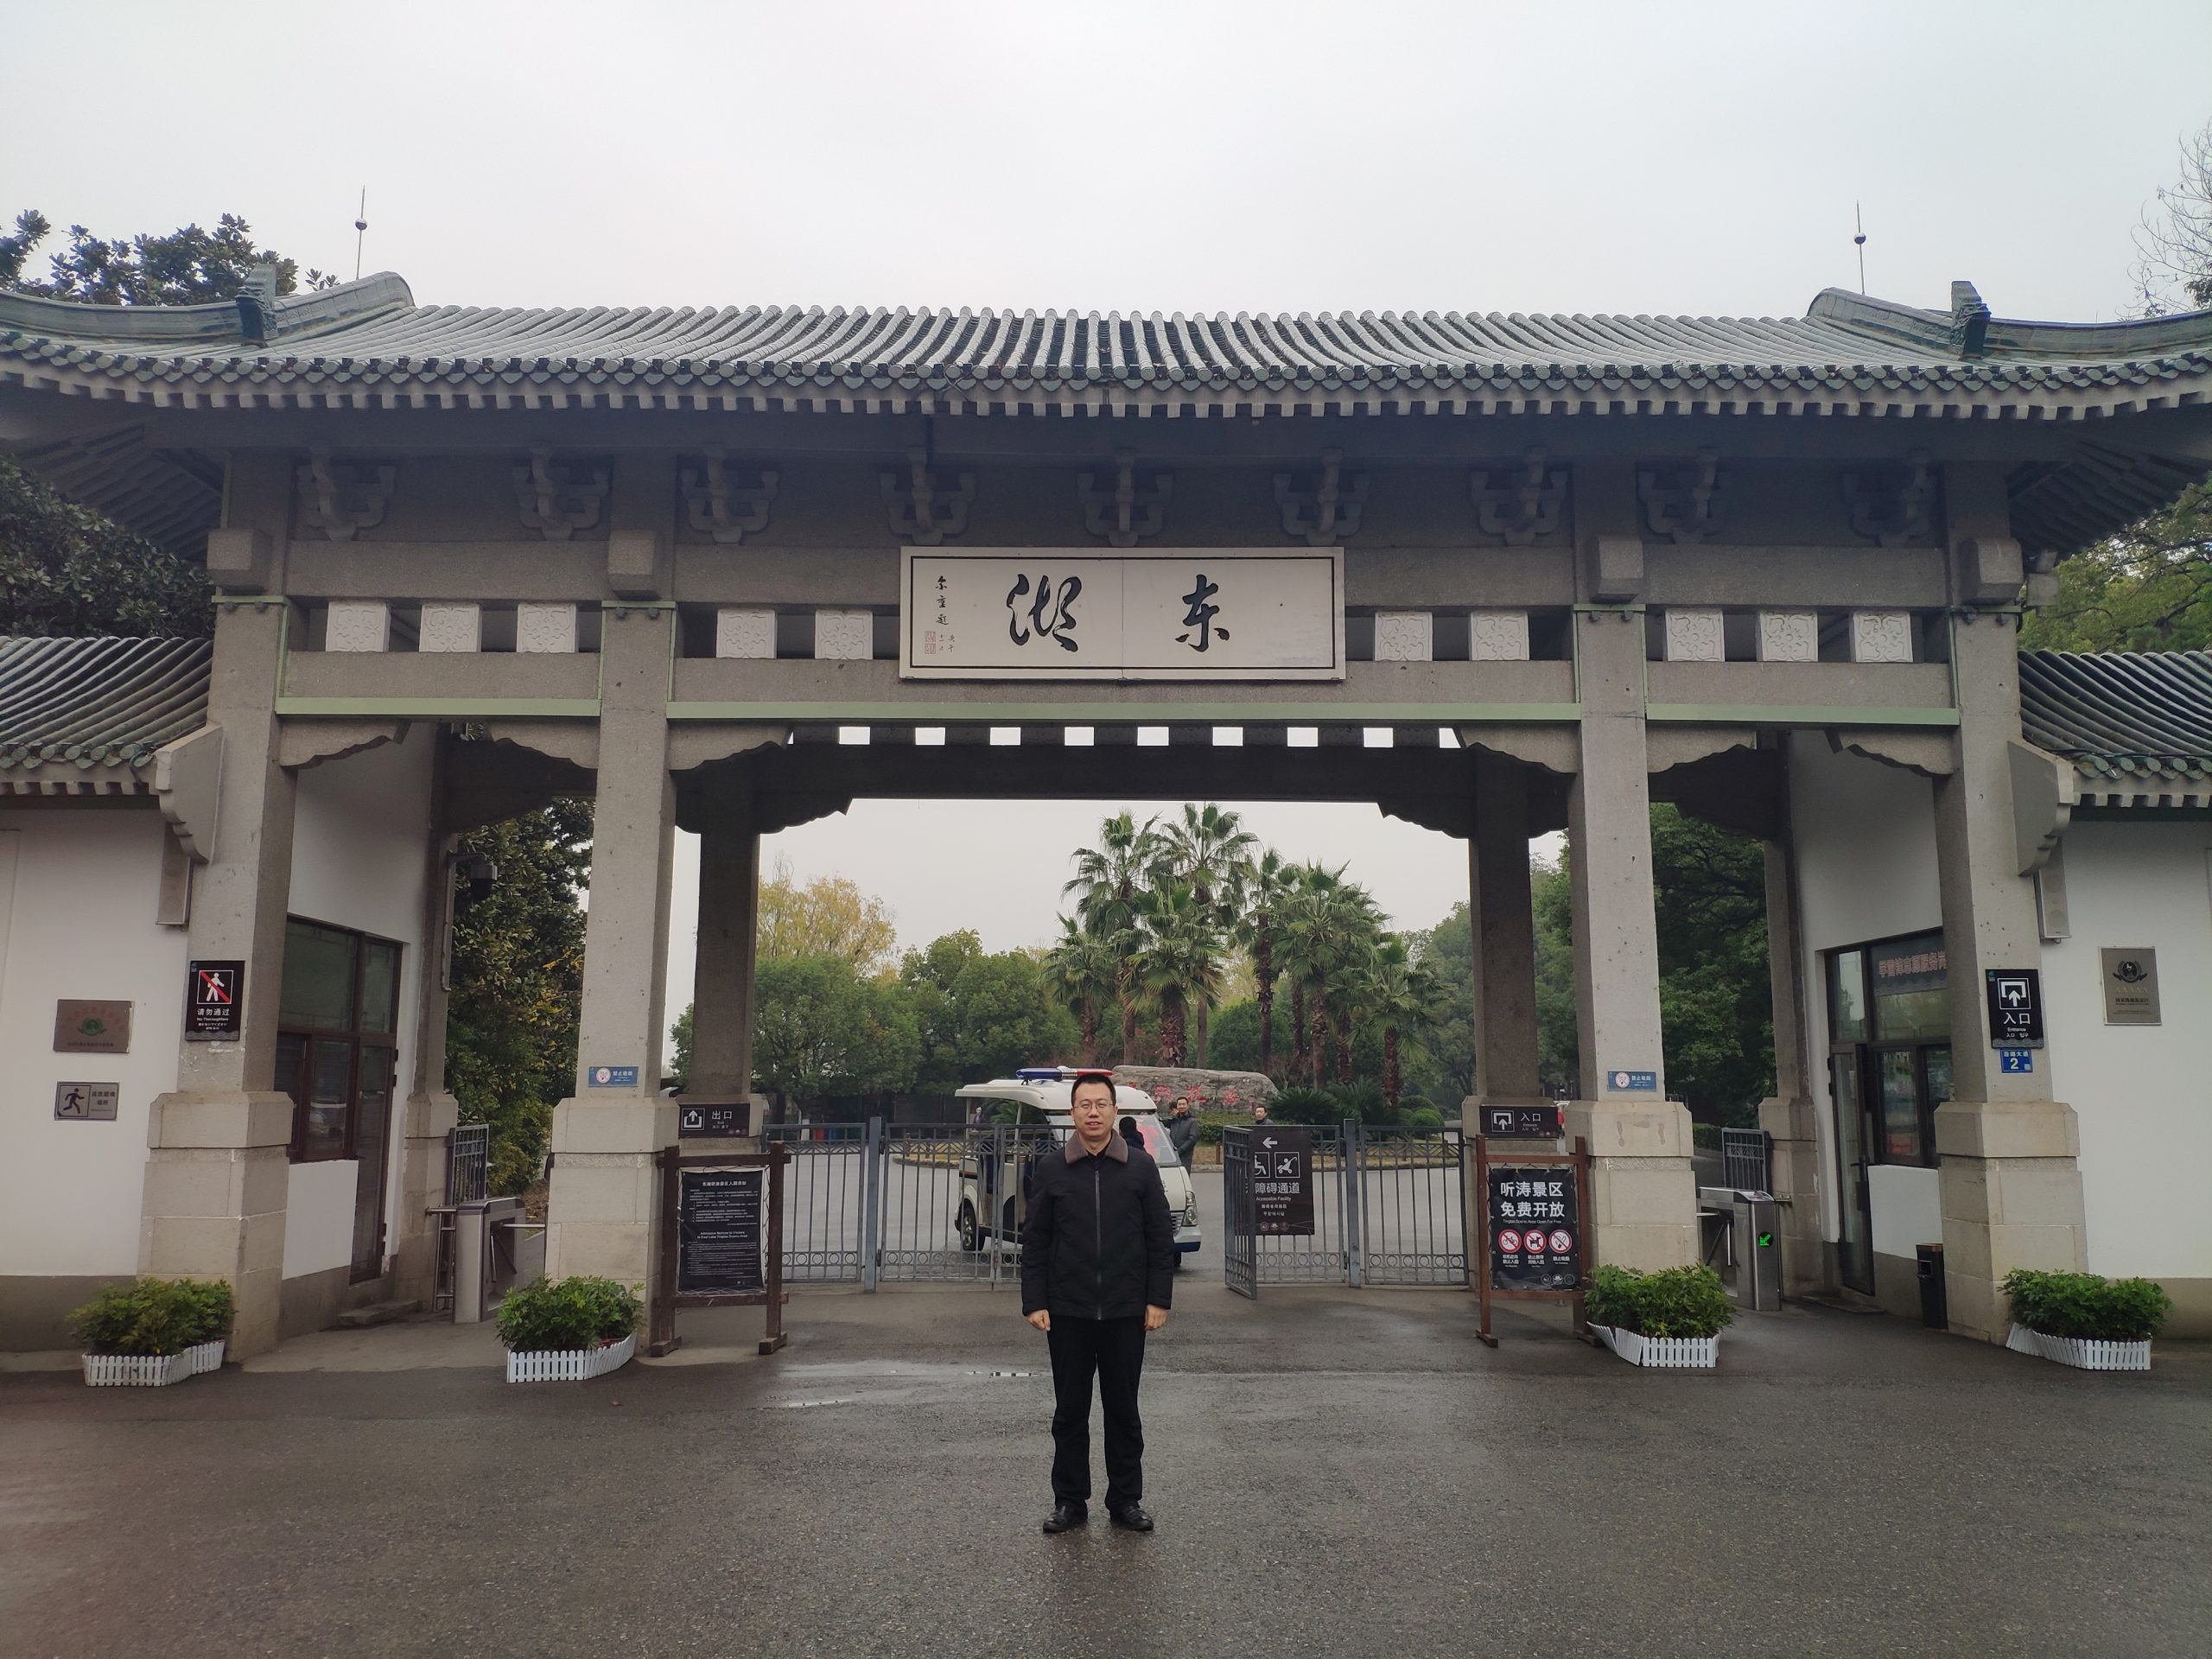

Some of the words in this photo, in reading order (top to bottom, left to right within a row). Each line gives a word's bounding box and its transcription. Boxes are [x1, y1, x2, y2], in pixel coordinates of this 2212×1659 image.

[2003, 1012, 2031, 1025] 入口
[2010, 1058, 2018, 1070] 2
[711, 1109, 733, 1120] 出口
[1520, 1112, 1541, 1122] 入口
[1245, 1181, 1300, 1194] 障碍通道
[1500, 1180, 1564, 1197] 听涛景区
[1500, 1201, 1565, 1217] 免费开放
